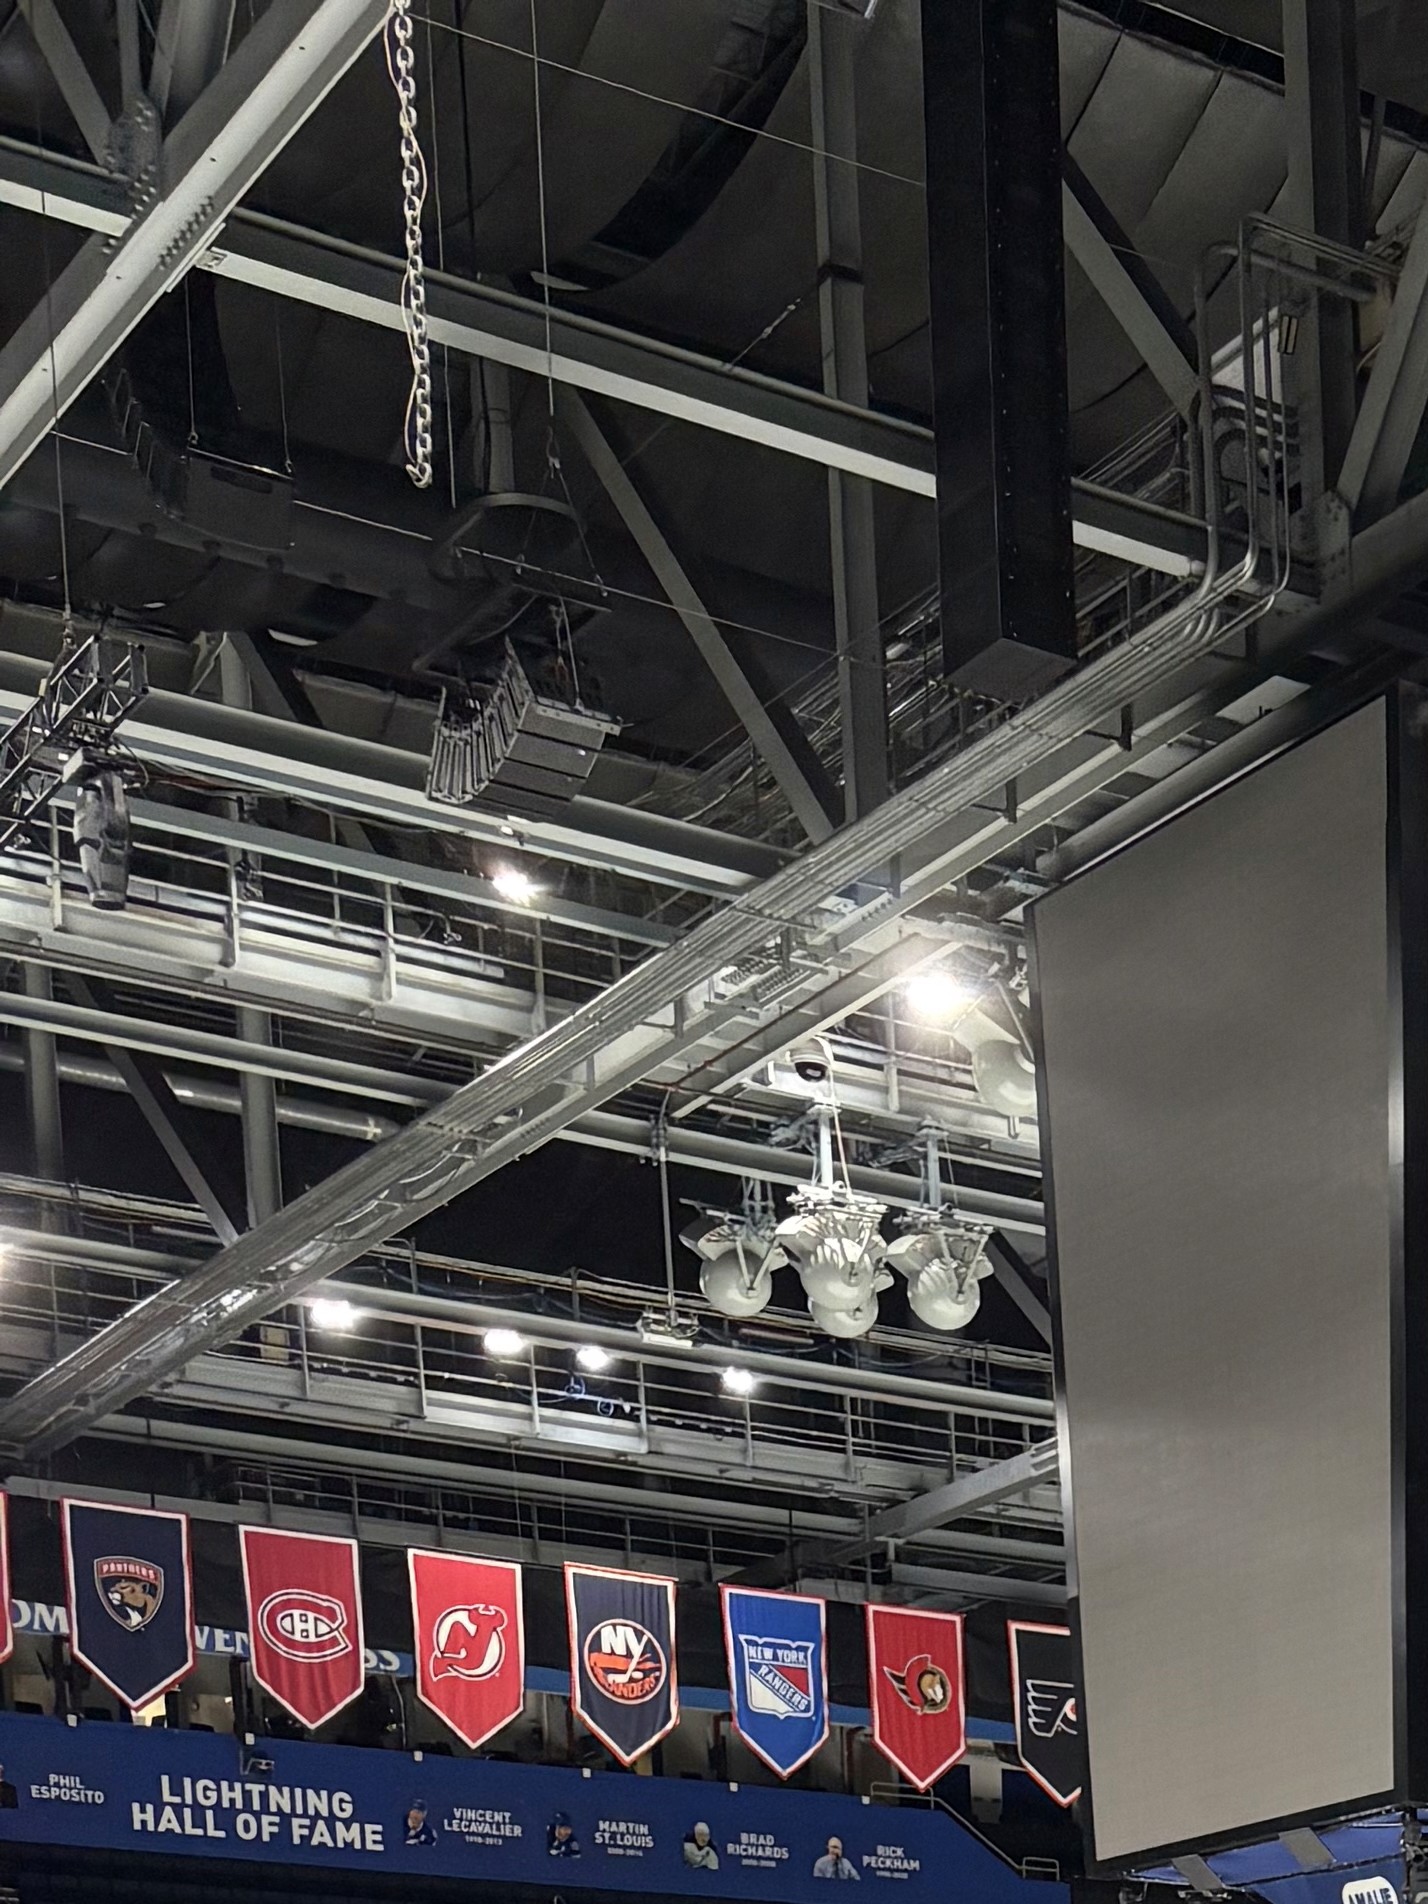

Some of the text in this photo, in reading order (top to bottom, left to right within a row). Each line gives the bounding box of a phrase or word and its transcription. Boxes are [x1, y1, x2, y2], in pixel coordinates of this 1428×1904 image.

[748, 1645, 808, 1668] NEW YORK
[48, 1773, 86, 1790] PHIL
[30, 1785, 105, 1804] ESPOSITO
[160, 1774, 354, 1818] LIGHTNING
[453, 1807, 512, 1823] VINCENT
[131, 1802, 385, 1851] HALL OF FAME
[443, 1818, 522, 1837] LECAVALIER
[598, 1820, 649, 1835] MARTIN
[594, 1832, 655, 1848] ST. LOUIS
[740, 1833, 775, 1846] BRAD
[726, 1843, 790, 1859] RICHARDS
[877, 1845, 905, 1858] RICK
[862, 1855, 921, 1871] PECKHAM
